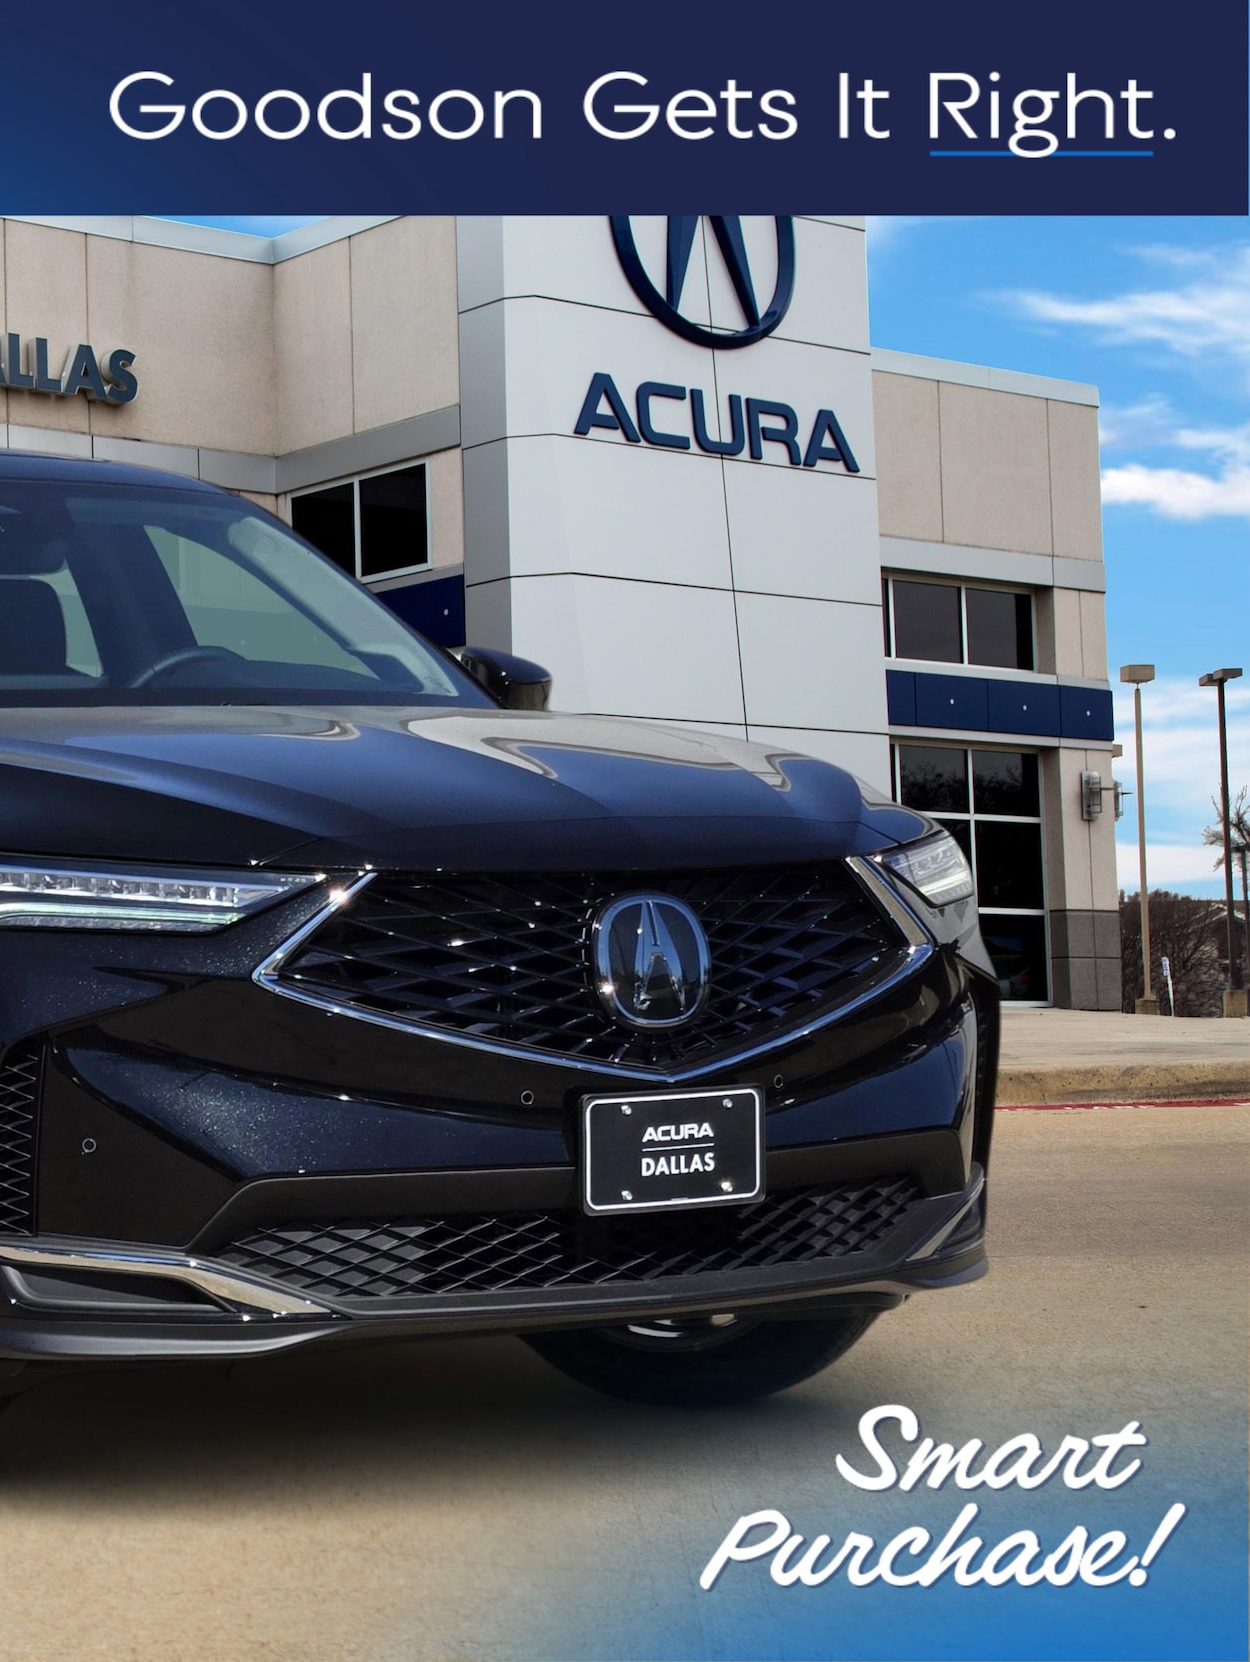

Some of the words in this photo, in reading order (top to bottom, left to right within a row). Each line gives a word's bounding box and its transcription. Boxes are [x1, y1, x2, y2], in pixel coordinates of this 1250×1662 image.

[573, 372, 860, 473] ACURA
[641, 1122, 714, 1144] ACURA
[641, 1151, 715, 1177] DALLAS
